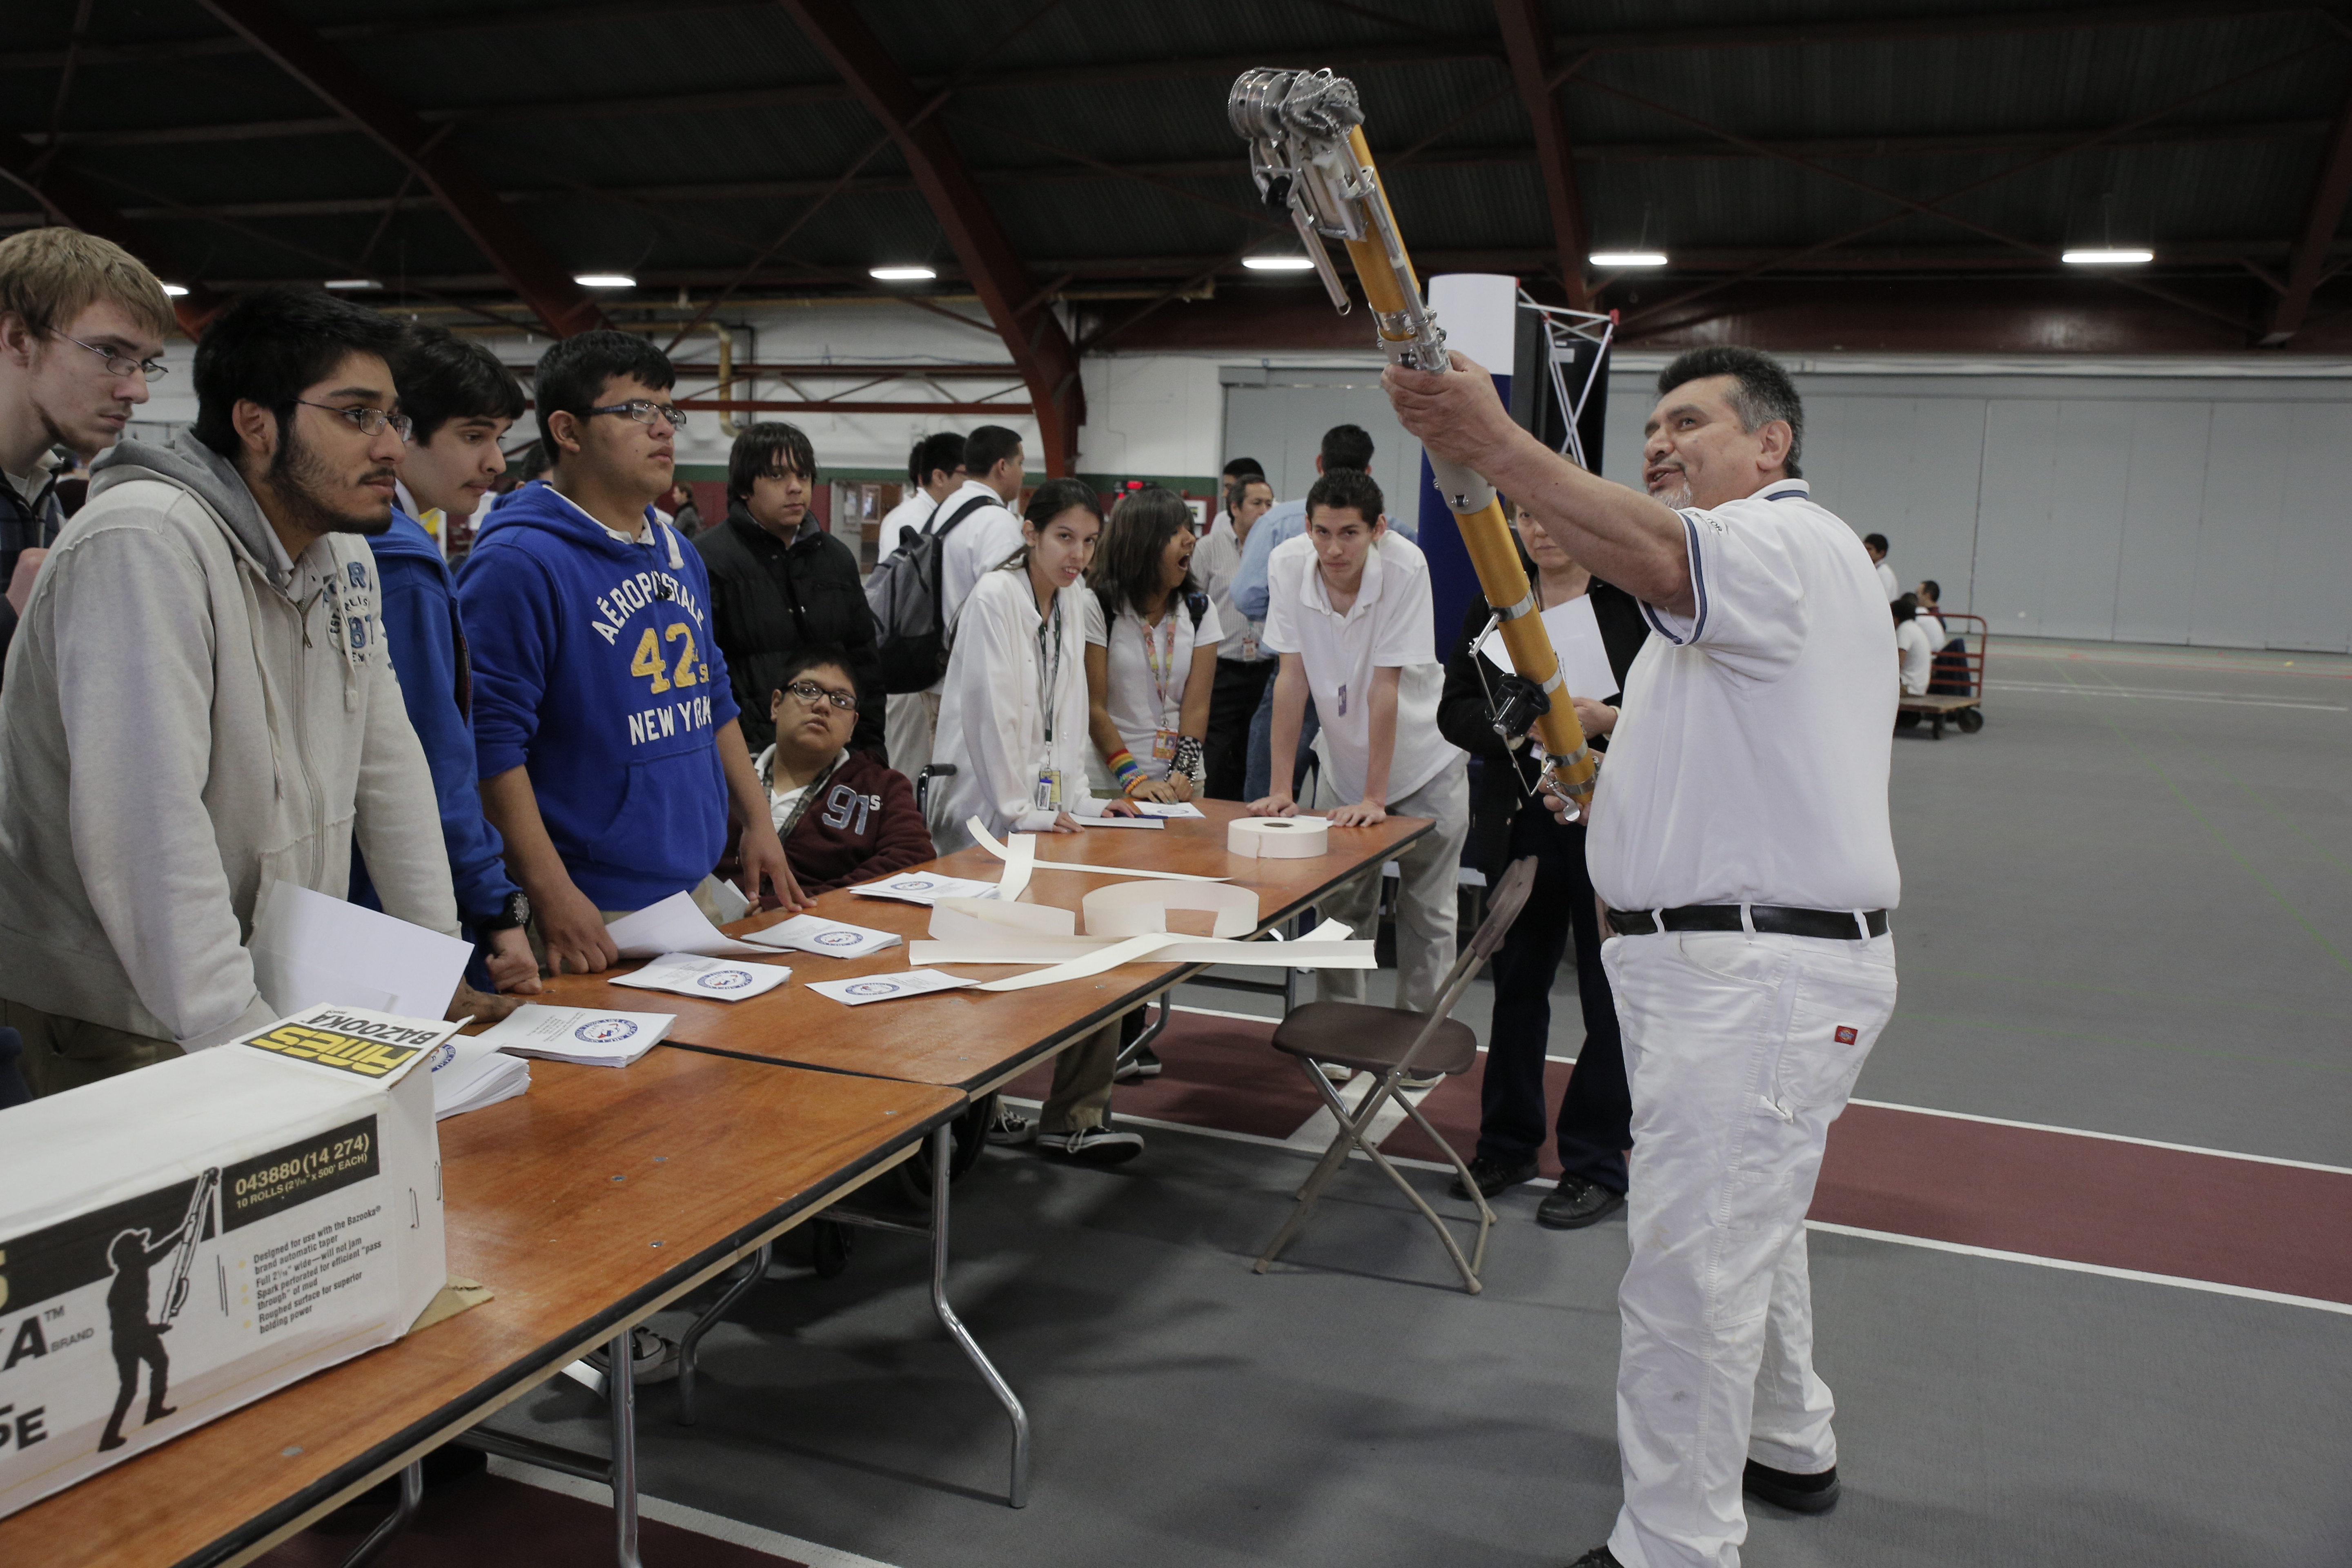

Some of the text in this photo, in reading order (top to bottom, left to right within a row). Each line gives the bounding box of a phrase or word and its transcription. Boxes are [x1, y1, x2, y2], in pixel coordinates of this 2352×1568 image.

[630, 623, 697, 694] 42
[628, 705, 675, 746] NEW
[250, 1026, 418, 1075] AMES
[235, 1133, 370, 1196] 043880 (14 274)
[236, 1197, 248, 1209] 10
[249, 1184, 283, 1205] ROLLS
[338, 1153, 368, 1171] EACH)
[254, 1242, 289, 1264] Designed
[290, 1238, 301, 1249] for
[303, 1232, 316, 1243] use
[317, 1225, 333, 1237] with
[334, 1220, 345, 1231] the
[254, 1234, 338, 1275] brand automatic taper
[256, 1274, 271, 1287] Full
[336, 1242, 347, 1254] not
[348, 1237, 362, 1250] jam
[257, 1285, 279, 1299] Spark
[281, 1267, 318, 1290] perforated
[320, 1263, 330, 1273] for
[332, 1250, 361, 1267] efficient
[259, 1271, 363, 1323] Roughed surface for superior
[292, 1285, 301, 1296] of
[302, 1277, 318, 1291] mud
[0, 1314, 48, 1372] A
[51, 1327, 95, 1352] BRAND
[260, 1305, 313, 1334] holding power
